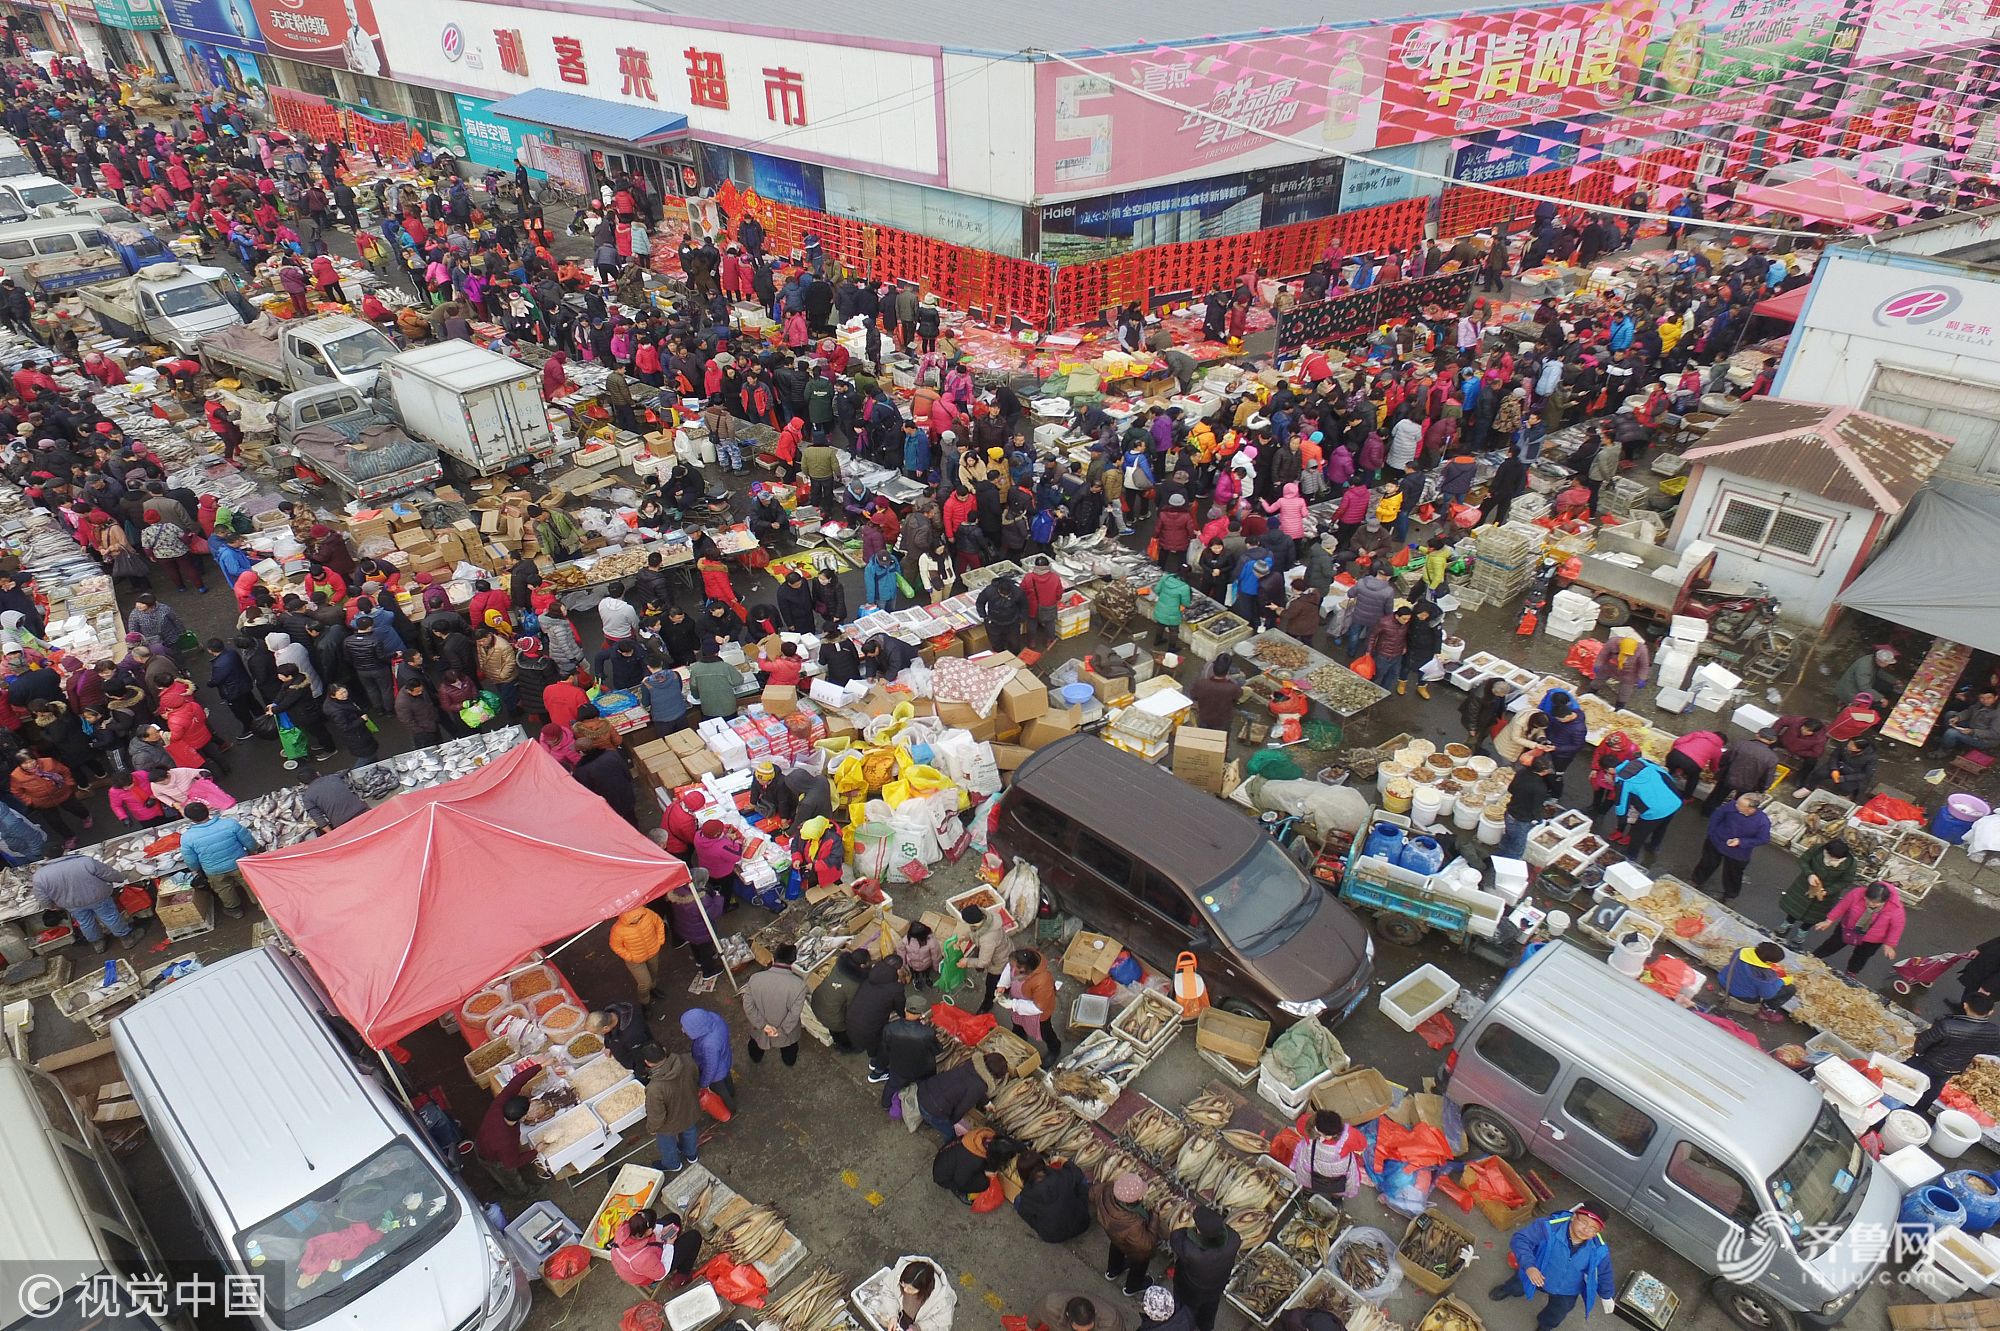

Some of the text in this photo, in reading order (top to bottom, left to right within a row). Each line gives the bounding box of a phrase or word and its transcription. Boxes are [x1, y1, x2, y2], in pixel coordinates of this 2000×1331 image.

[270, 9, 330, 37] 无淀粉烤肠
[1422, 17, 1625, 108] 华清肉食
[1142, 62, 1194, 92] 喜燕
[463, 117, 512, 145] 海信空调
[1204, 143, 1231, 161] FRESH
[1042, 205, 1078, 221] Haier
[1927, 329, 1994, 347] LIKELAI
